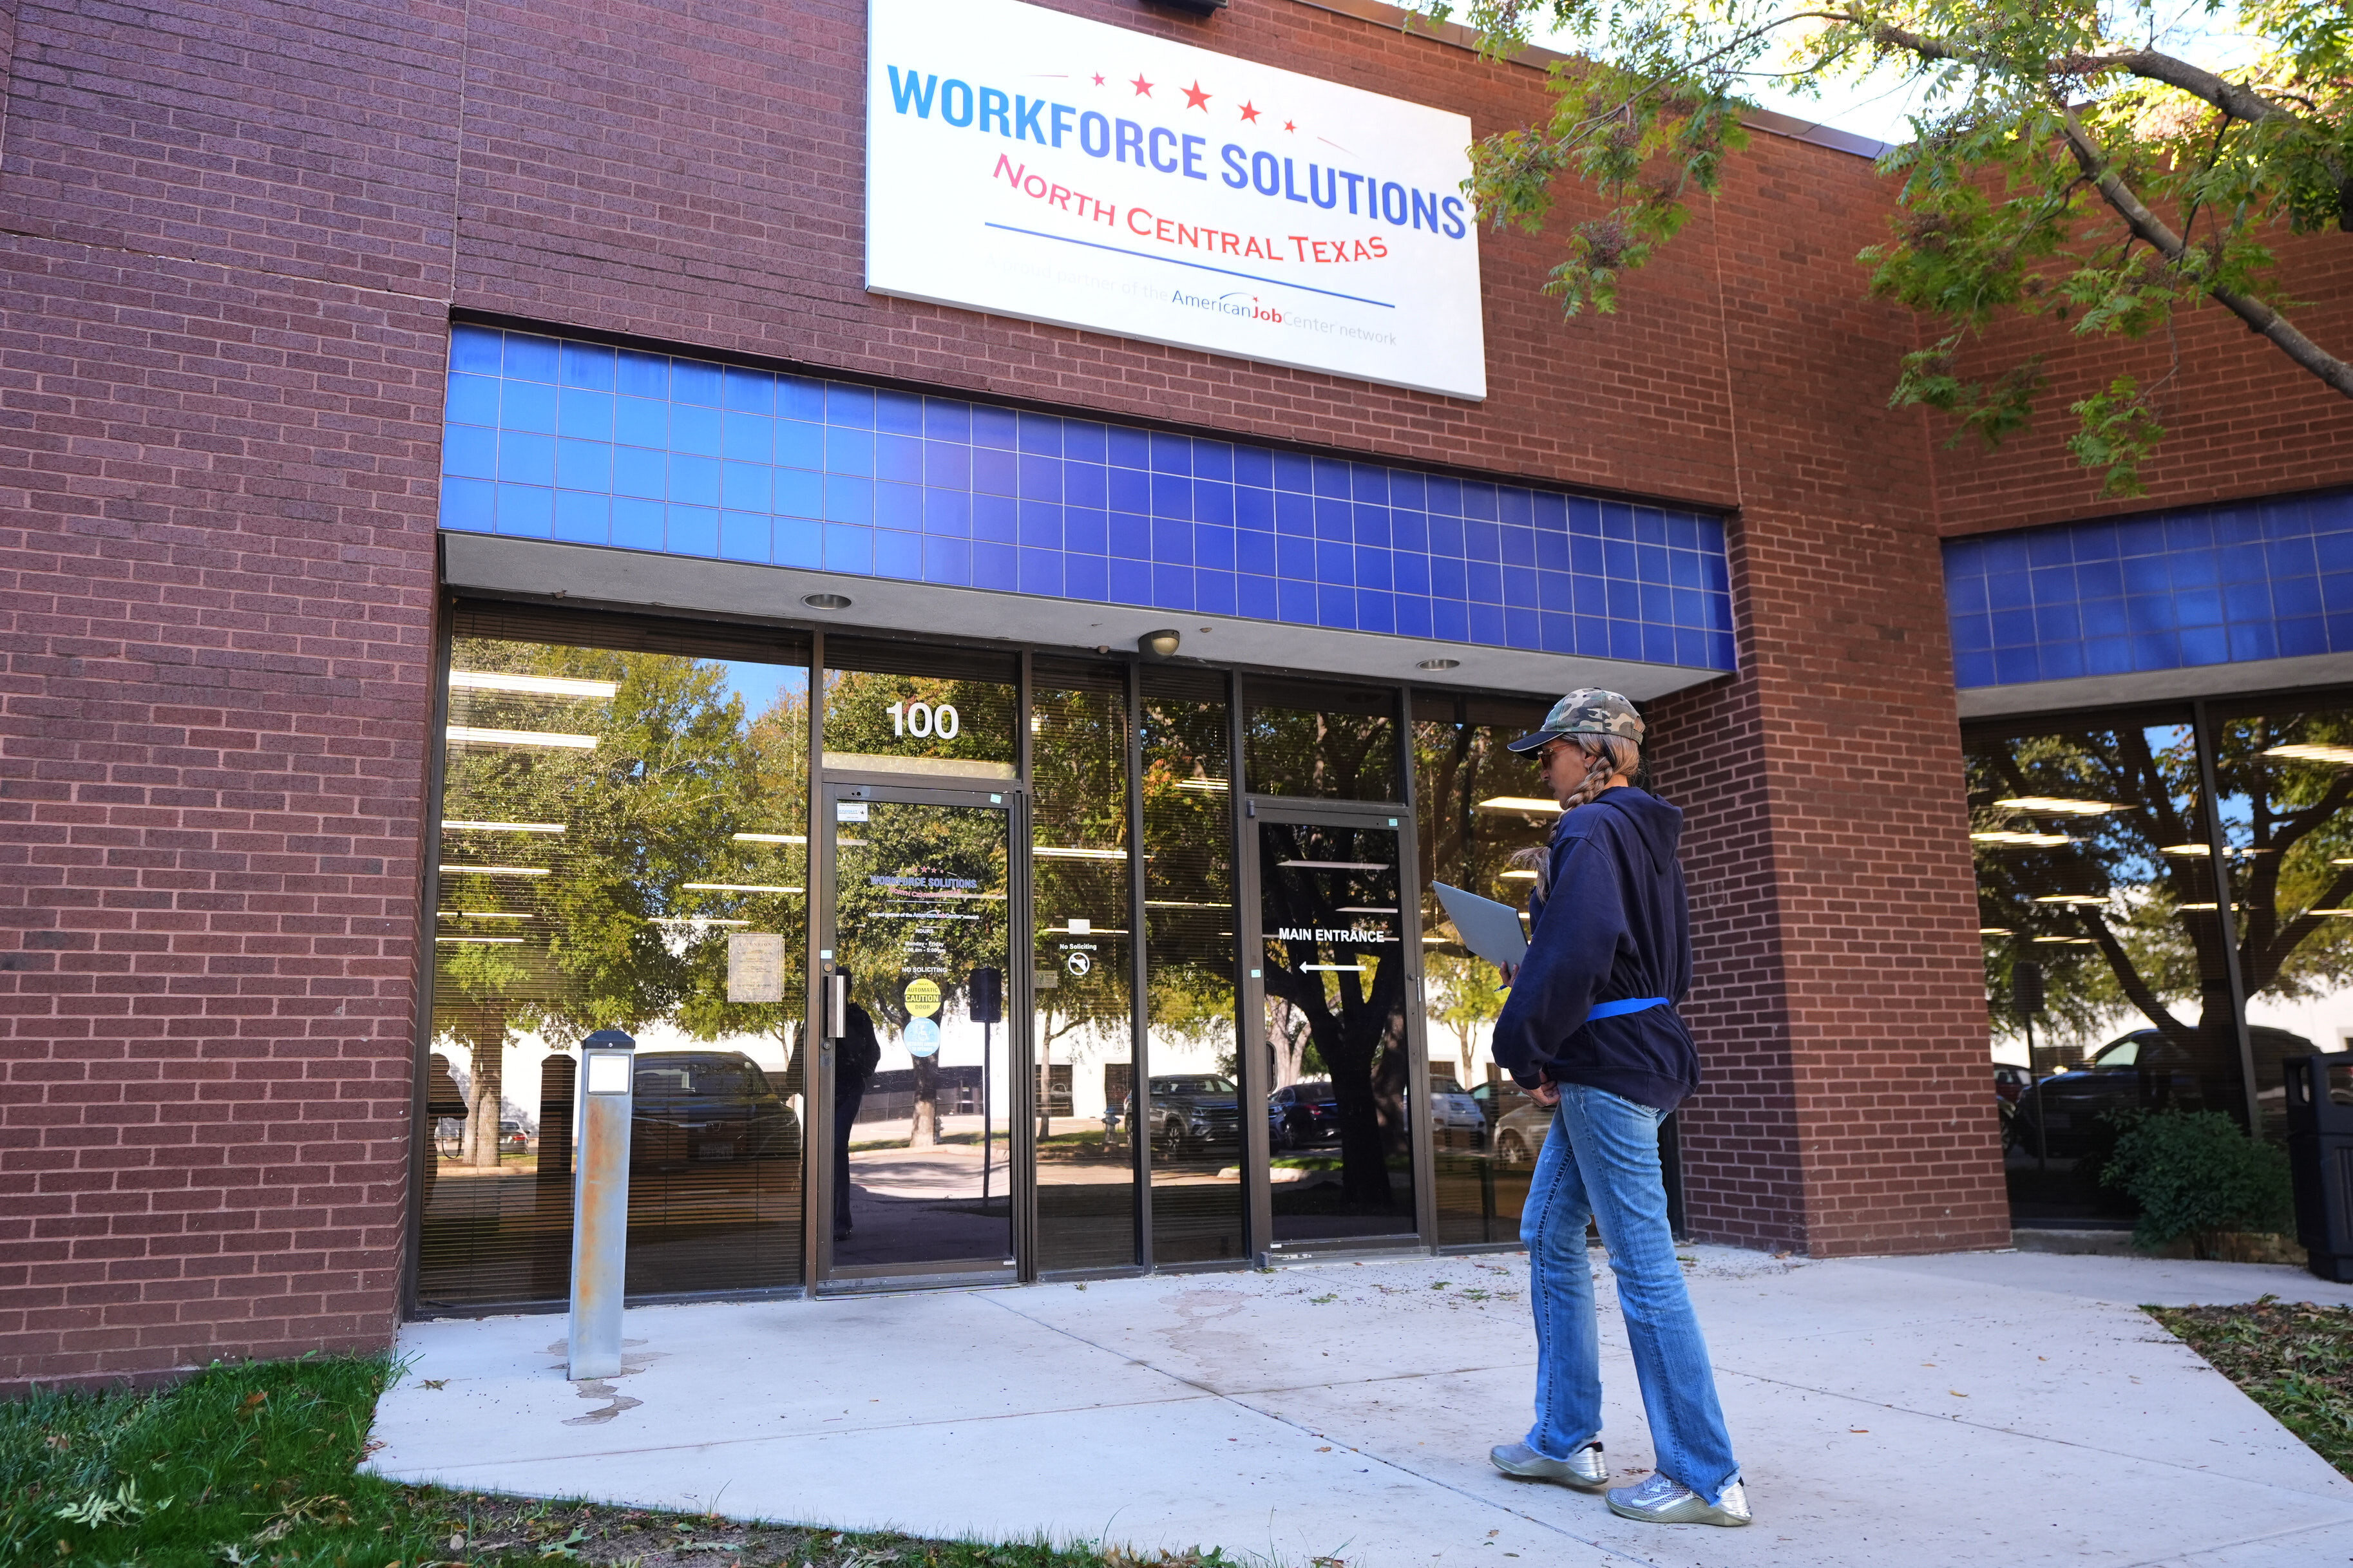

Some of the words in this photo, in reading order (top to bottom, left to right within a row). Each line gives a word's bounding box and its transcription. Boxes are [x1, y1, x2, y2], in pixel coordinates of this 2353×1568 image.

[886, 64, 1208, 182] WORKFORCE
[1221, 143, 1467, 240] SOLUTIONS
[993, 153, 1116, 227] NORTH
[1127, 207, 1284, 261] CENTRAL
[1288, 236, 1388, 264] TEXAS
[1057, 270, 1118, 292] partner
[1122, 281, 1139, 296] of
[1143, 283, 1168, 301] the
[1340, 322, 1397, 346] network
[886, 701, 959, 739] 100
[870, 875, 926, 887] WORKFORCE
[928, 878, 978, 889] SOLUTIONS
[888, 887, 911, 897] NORTH
[1279, 927, 1312, 941] MAIN
[1315, 929, 1385, 943] ENTRANCE
